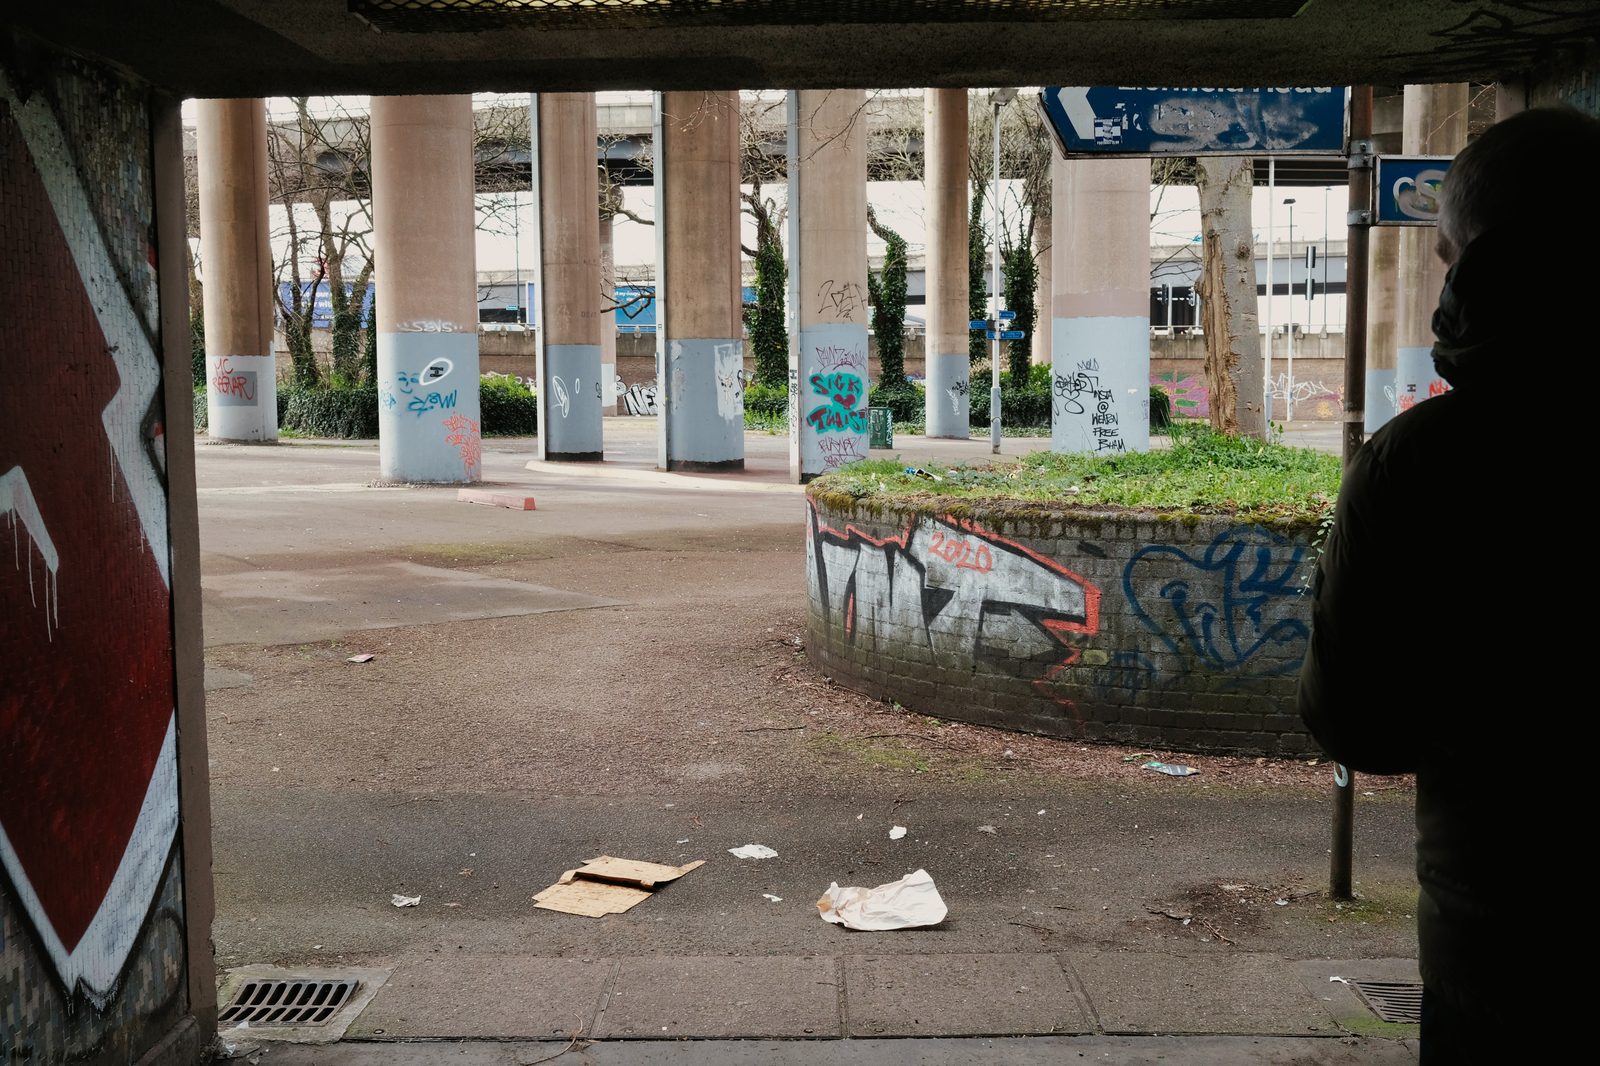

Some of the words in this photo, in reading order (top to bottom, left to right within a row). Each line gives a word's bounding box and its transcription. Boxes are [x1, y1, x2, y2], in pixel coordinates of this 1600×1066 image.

[810, 374, 861, 395] SICK
[1092, 427, 1119, 437] FREE
[928, 532, 992, 575] 2020
